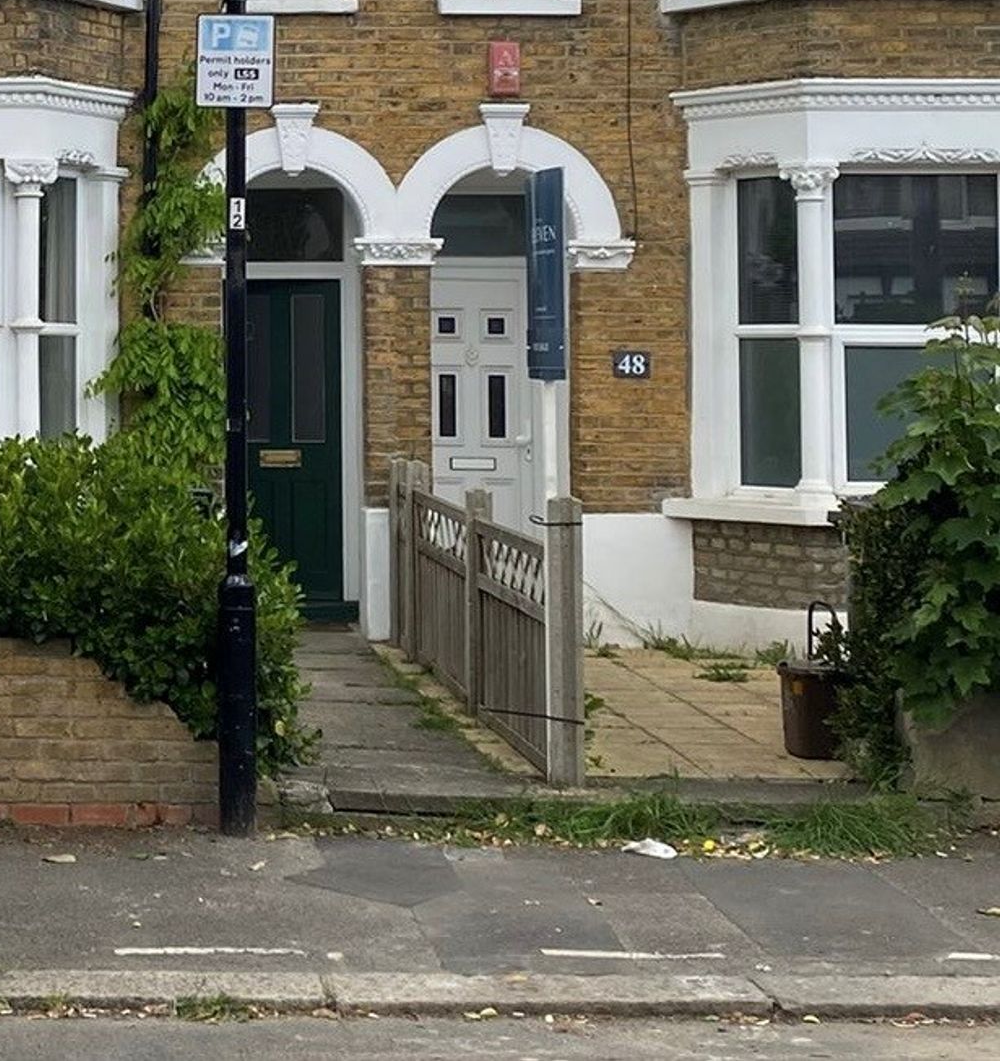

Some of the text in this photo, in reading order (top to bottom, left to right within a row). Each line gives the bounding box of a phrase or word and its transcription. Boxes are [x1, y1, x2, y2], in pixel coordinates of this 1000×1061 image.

[212, 23, 231, 48] P
[200, 55, 271, 65] Permit holders
[208, 69, 229, 79] only
[213, 82, 233, 91] Mon
[241, 83, 255, 91] Fri
[618, 354, 645, 375] 48
